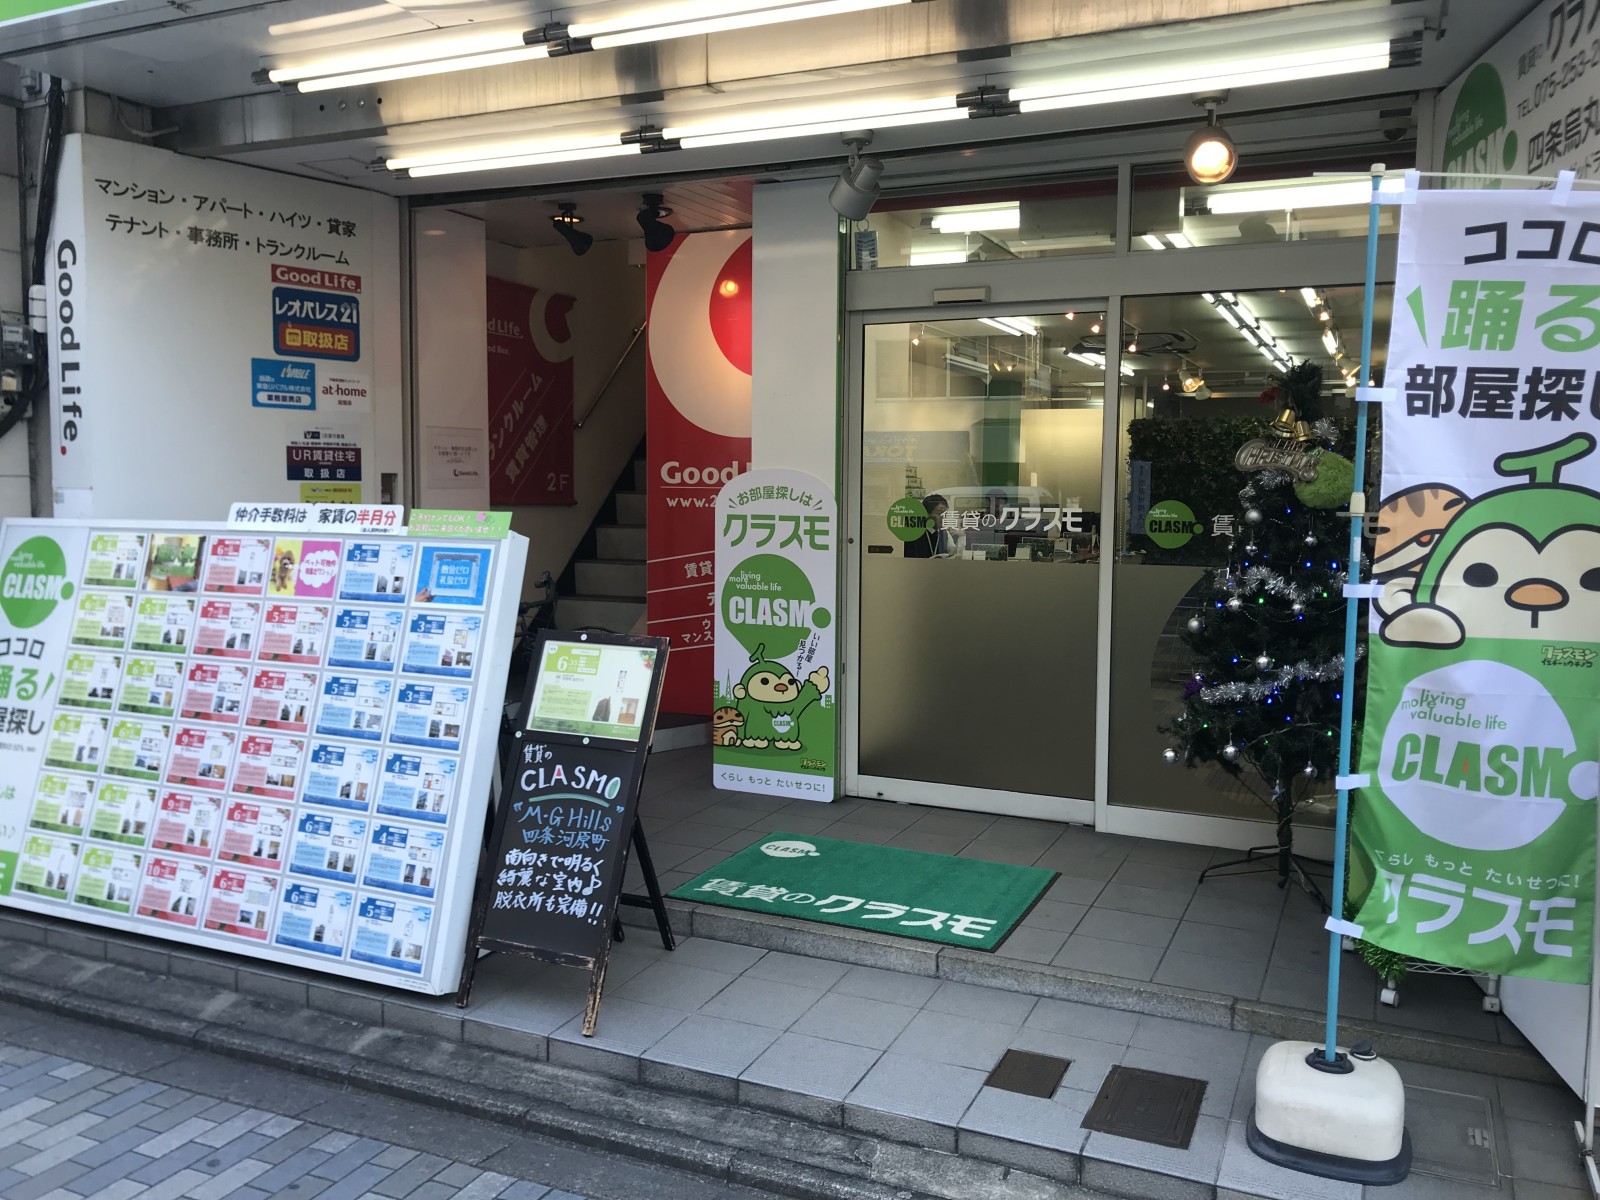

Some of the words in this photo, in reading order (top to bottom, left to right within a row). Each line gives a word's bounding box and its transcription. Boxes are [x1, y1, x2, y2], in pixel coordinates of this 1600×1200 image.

[276, 267, 321, 285] Good
[57, 239, 81, 351] Good
[275, 297, 358, 324] レオパレス21
[1440, 279, 1600, 353] 踊る
[736, 485, 813, 507] お部屋探しは
[235, 506, 308, 524] 仲介手数料は
[317, 508, 397, 526] 家賃の半月分
[940, 507, 1083, 532] 賃貸のクラスモ
[723, 513, 830, 551] クラスモ
[736, 582, 769, 591] valuable
[770, 582, 782, 592] life
[1541, 645, 1599, 662] クラスモン
[1420, 688, 1466, 710] living
[1410, 706, 1482, 731] valuable
[1484, 714, 1507, 731] life
[520, 764, 621, 800] CLASMO
[721, 772, 743, 782] くらし
[748, 775, 771, 786] もっと
[521, 825, 610, 852] 四条河原町
[505, 848, 604, 876] 南向きで明るく
[1424, 854, 1473, 877] もっと
[694, 878, 998, 939] 賃貸のクラスモ
